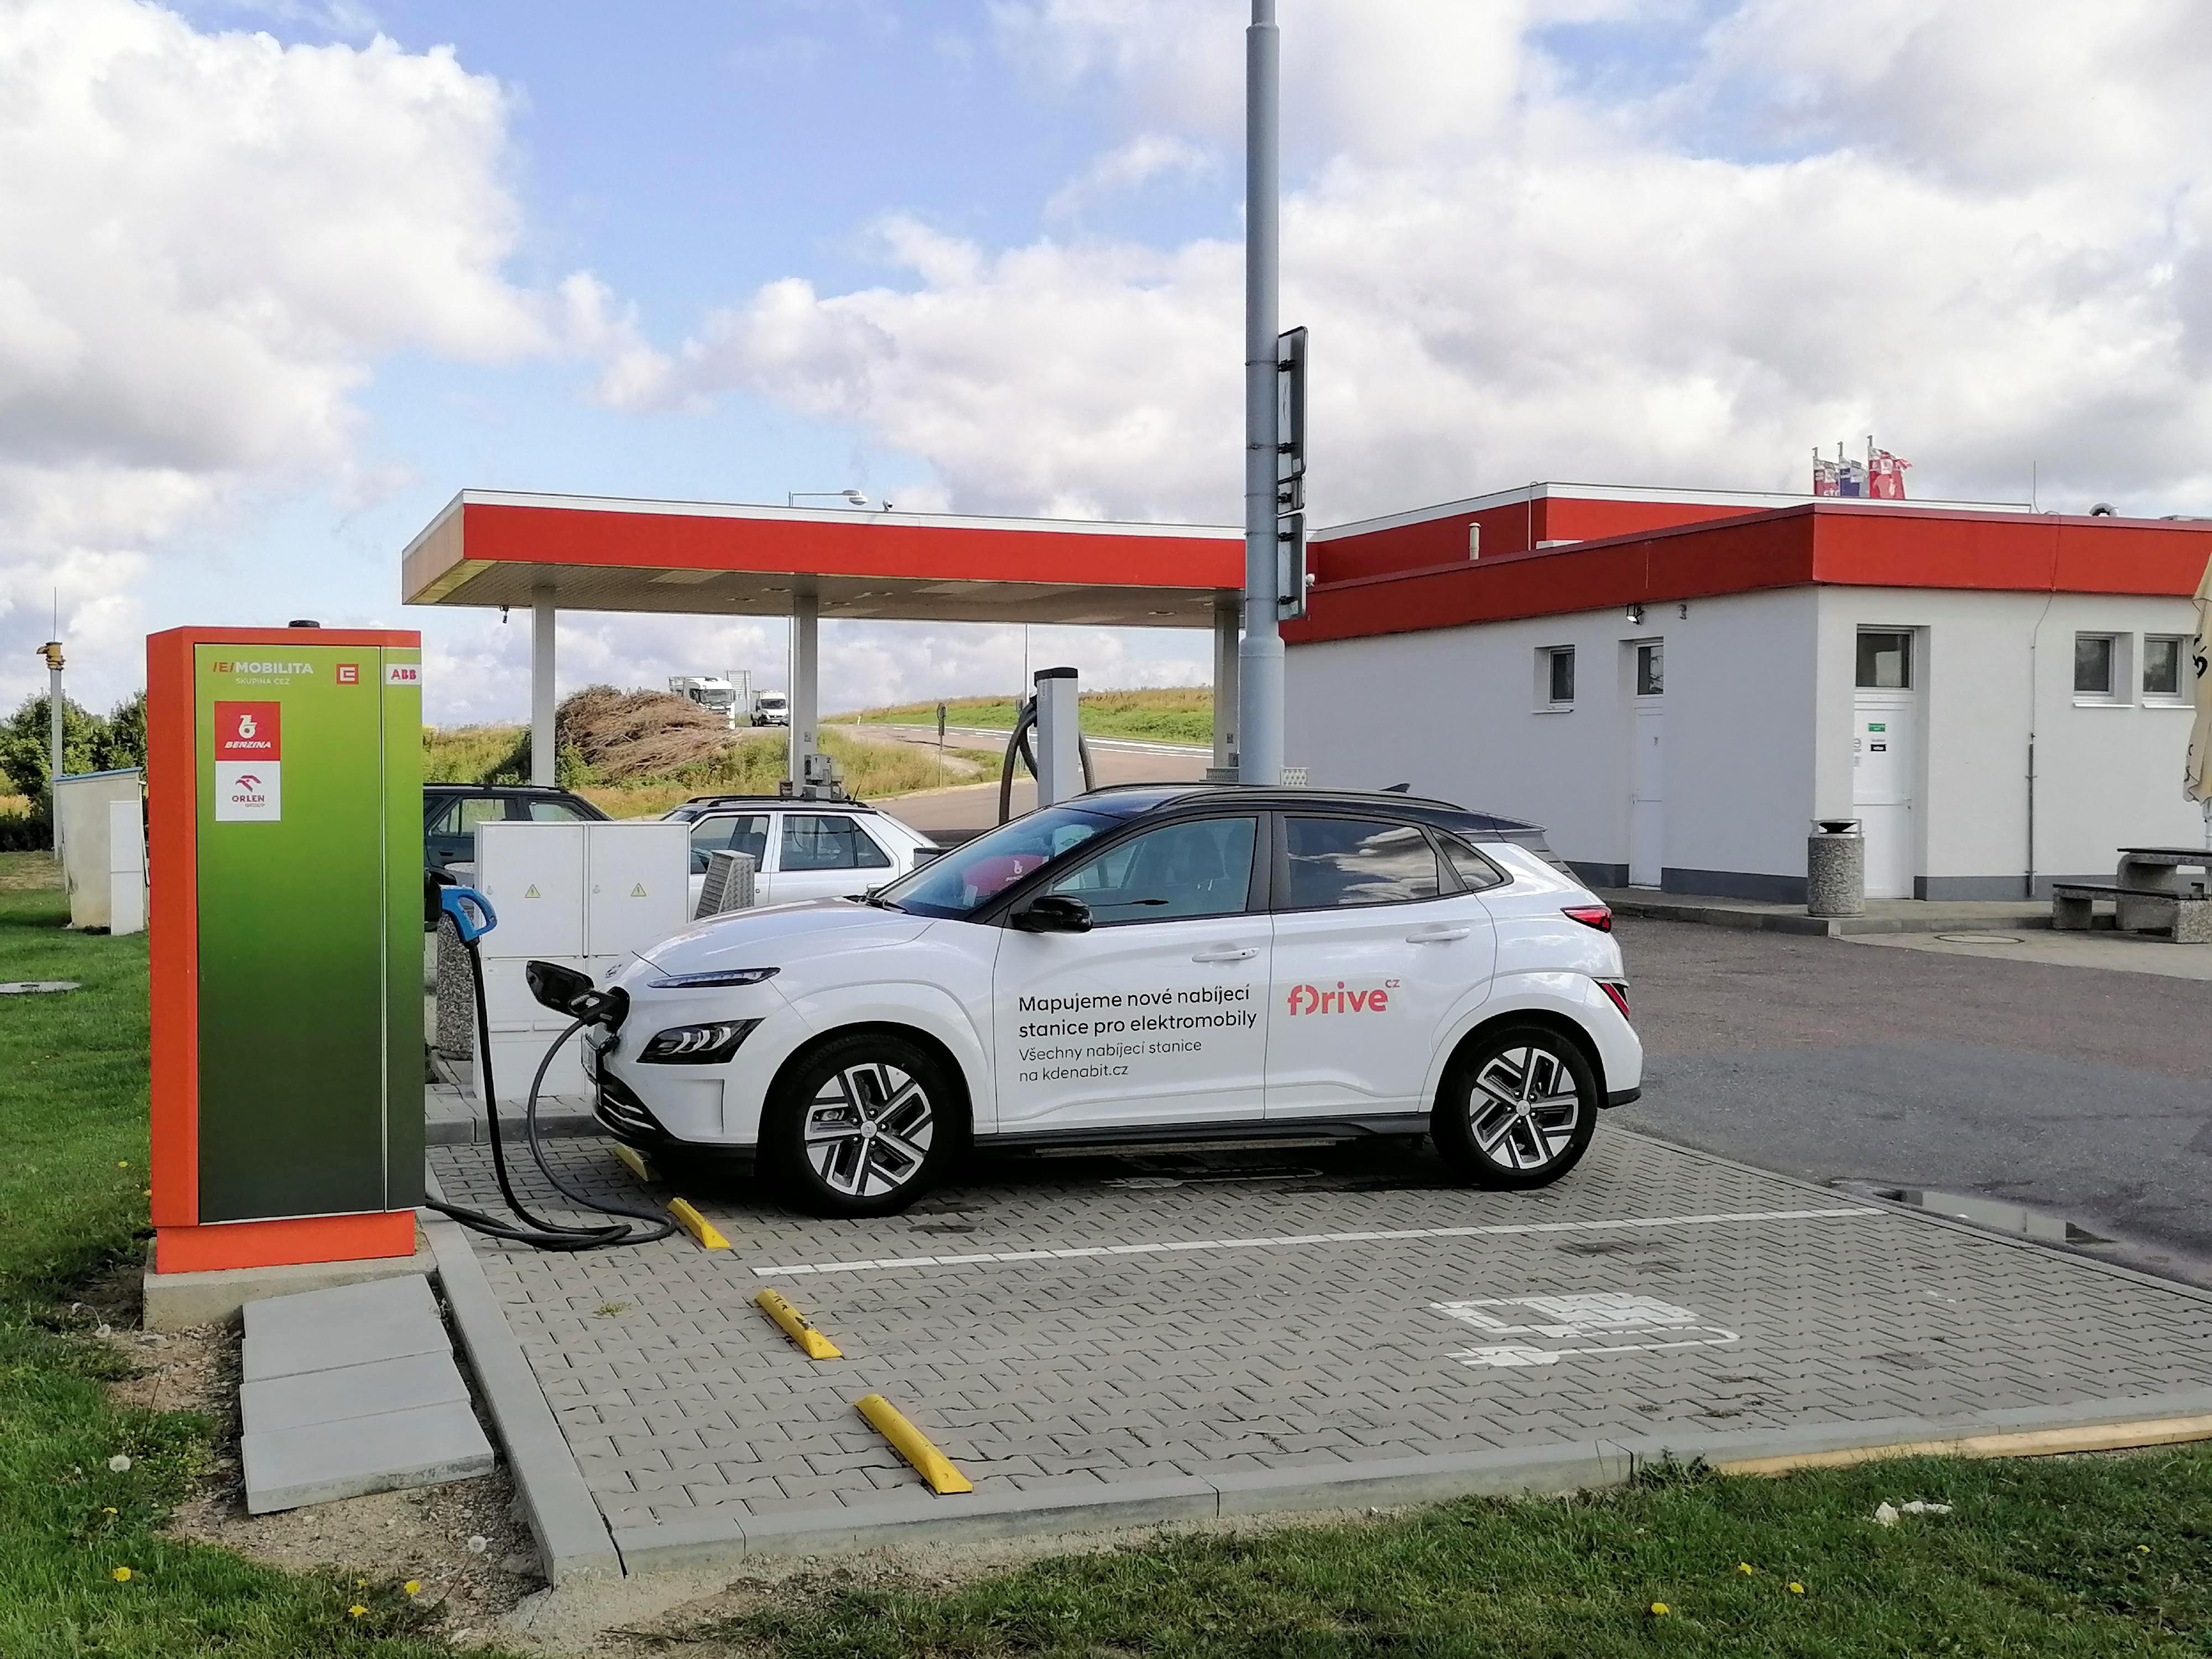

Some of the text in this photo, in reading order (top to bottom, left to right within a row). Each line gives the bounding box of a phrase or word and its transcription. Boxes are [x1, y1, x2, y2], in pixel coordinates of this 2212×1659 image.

[391, 669, 416, 680] ABB
[1019, 983, 1250, 1014] Mapujeme nové nabíjecí
[1019, 1009, 1257, 1037] stanice pro elektromobily
[1019, 1039, 1202, 1061] Všechny nabíjecí stanice
[1020, 1063, 1129, 1082] na kdenabit.cz
